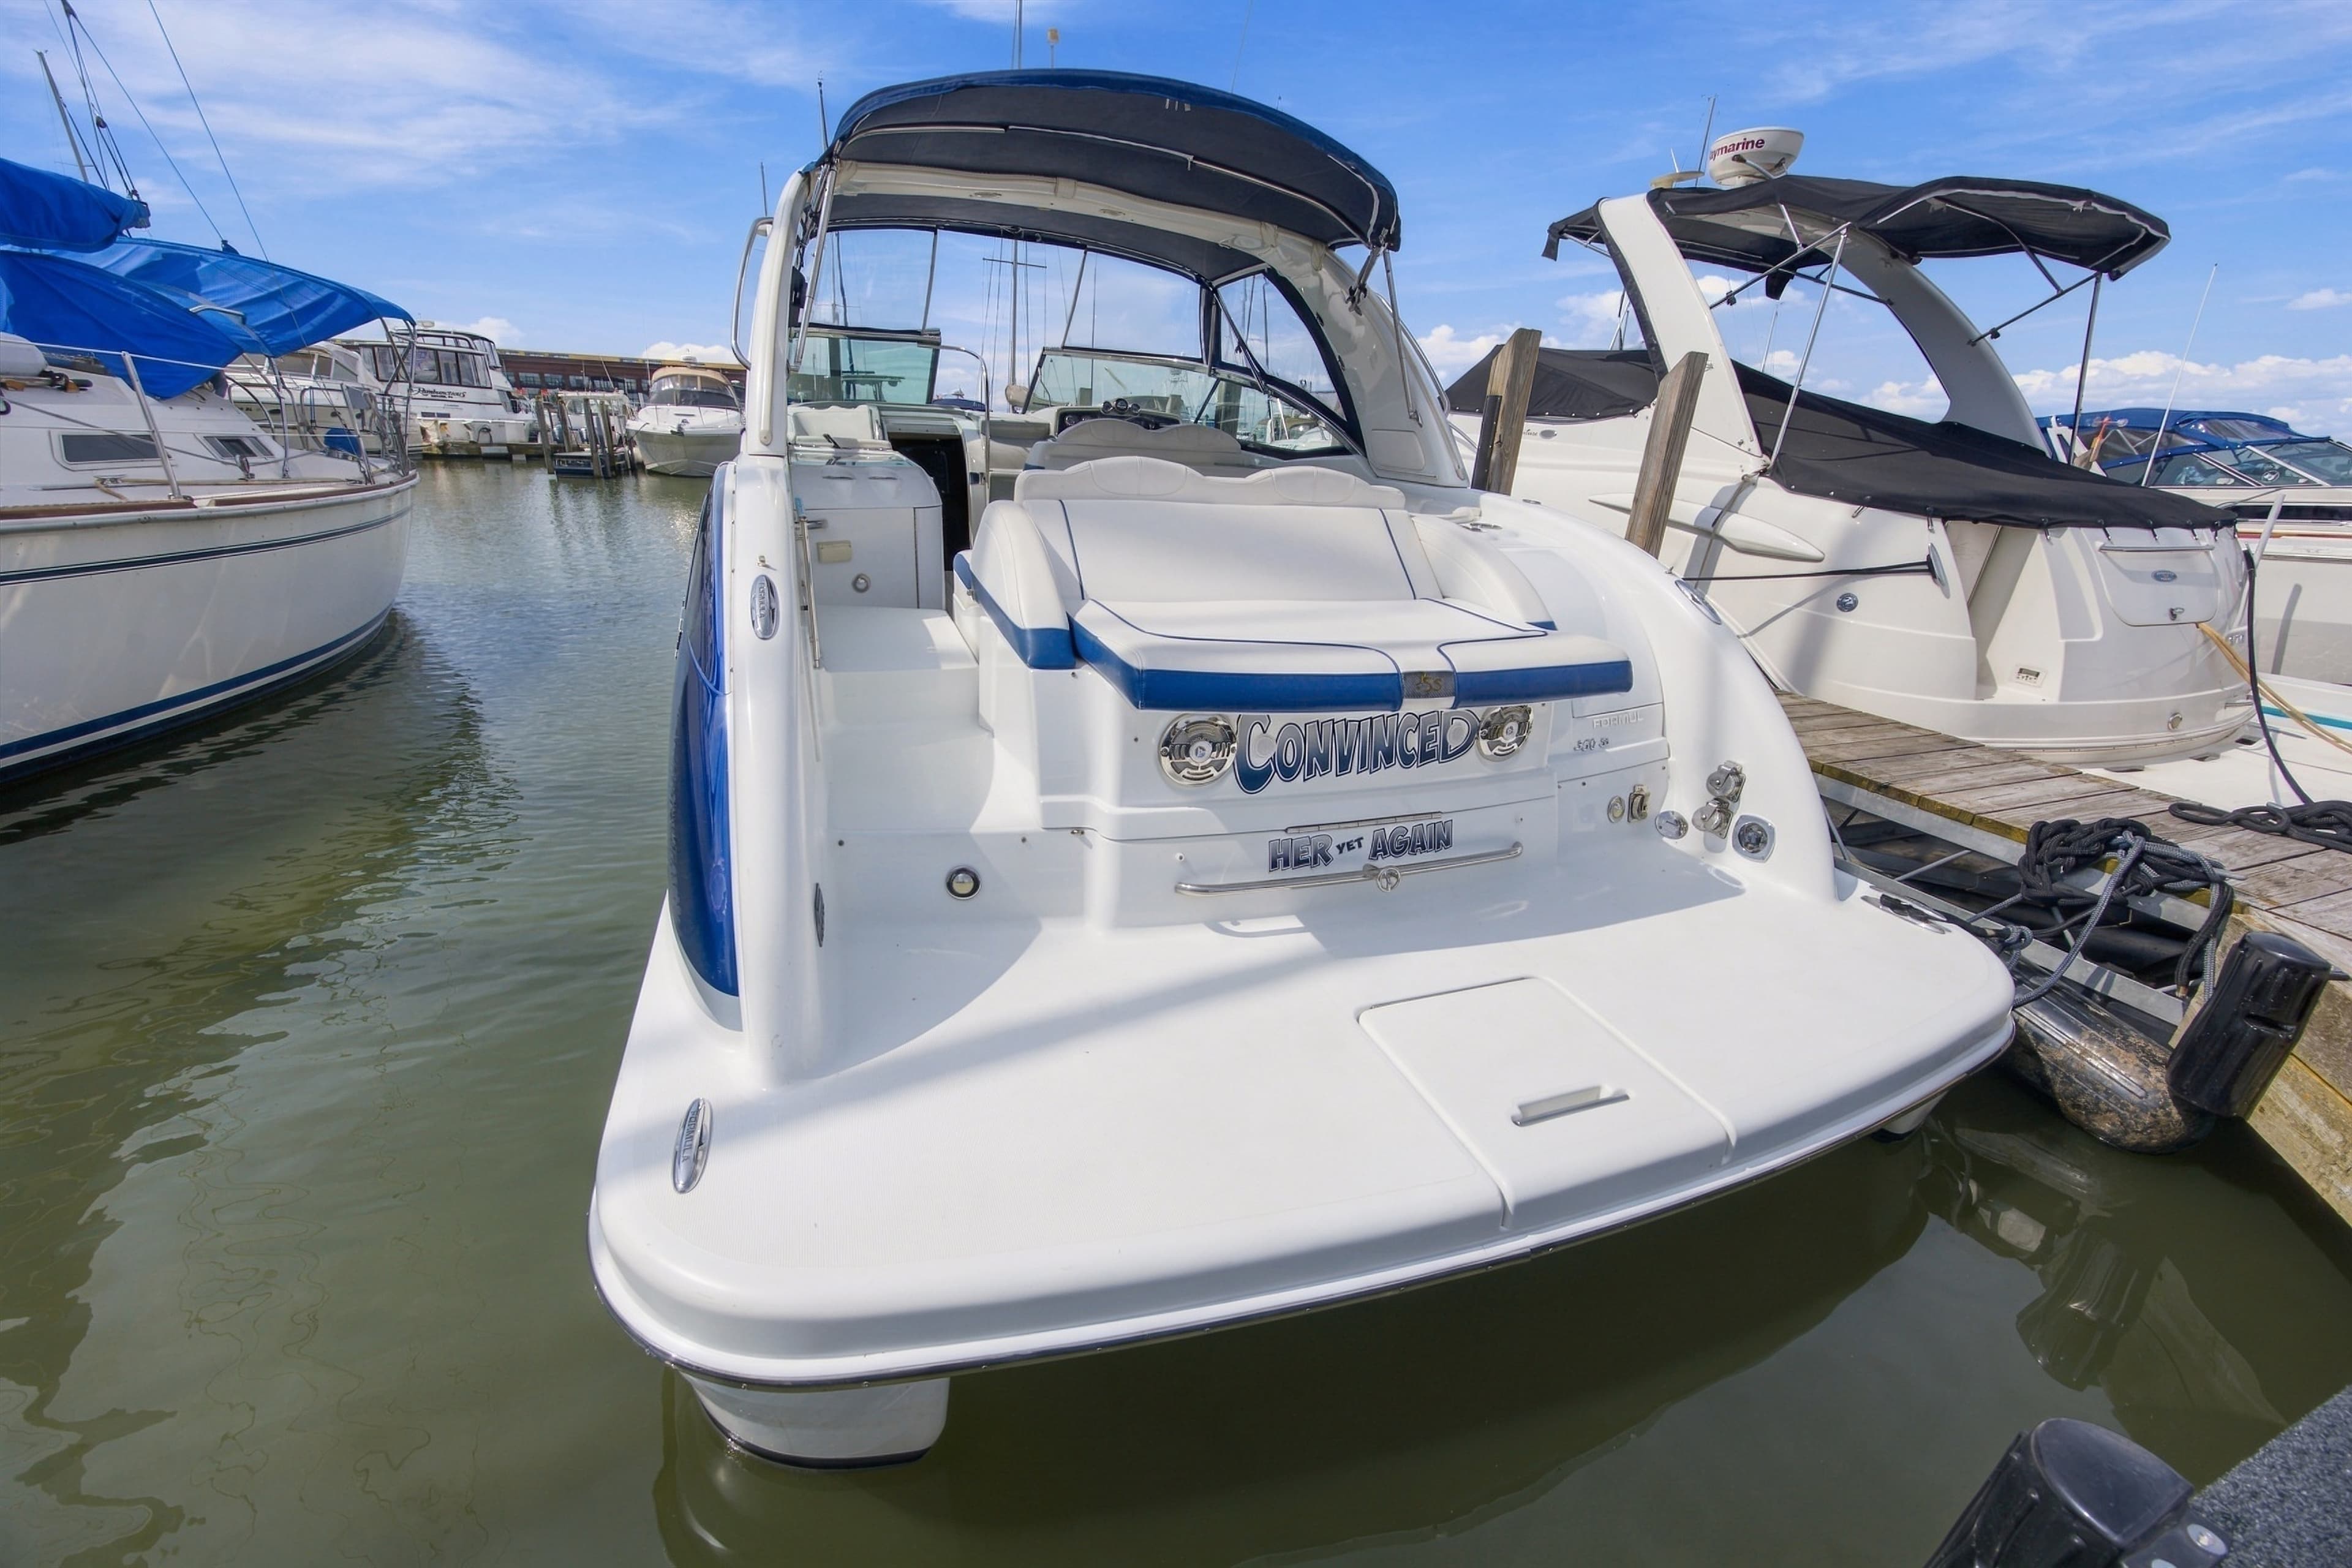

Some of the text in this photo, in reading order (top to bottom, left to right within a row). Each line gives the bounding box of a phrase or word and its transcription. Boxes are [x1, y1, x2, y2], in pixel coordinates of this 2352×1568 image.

[1709, 138, 1765, 161] aymarine
[1233, 709, 1481, 794] CONVINCED
[1268, 820, 1453, 872] HER YET AGAIN
[682, 1110, 697, 1163] FORMULA
